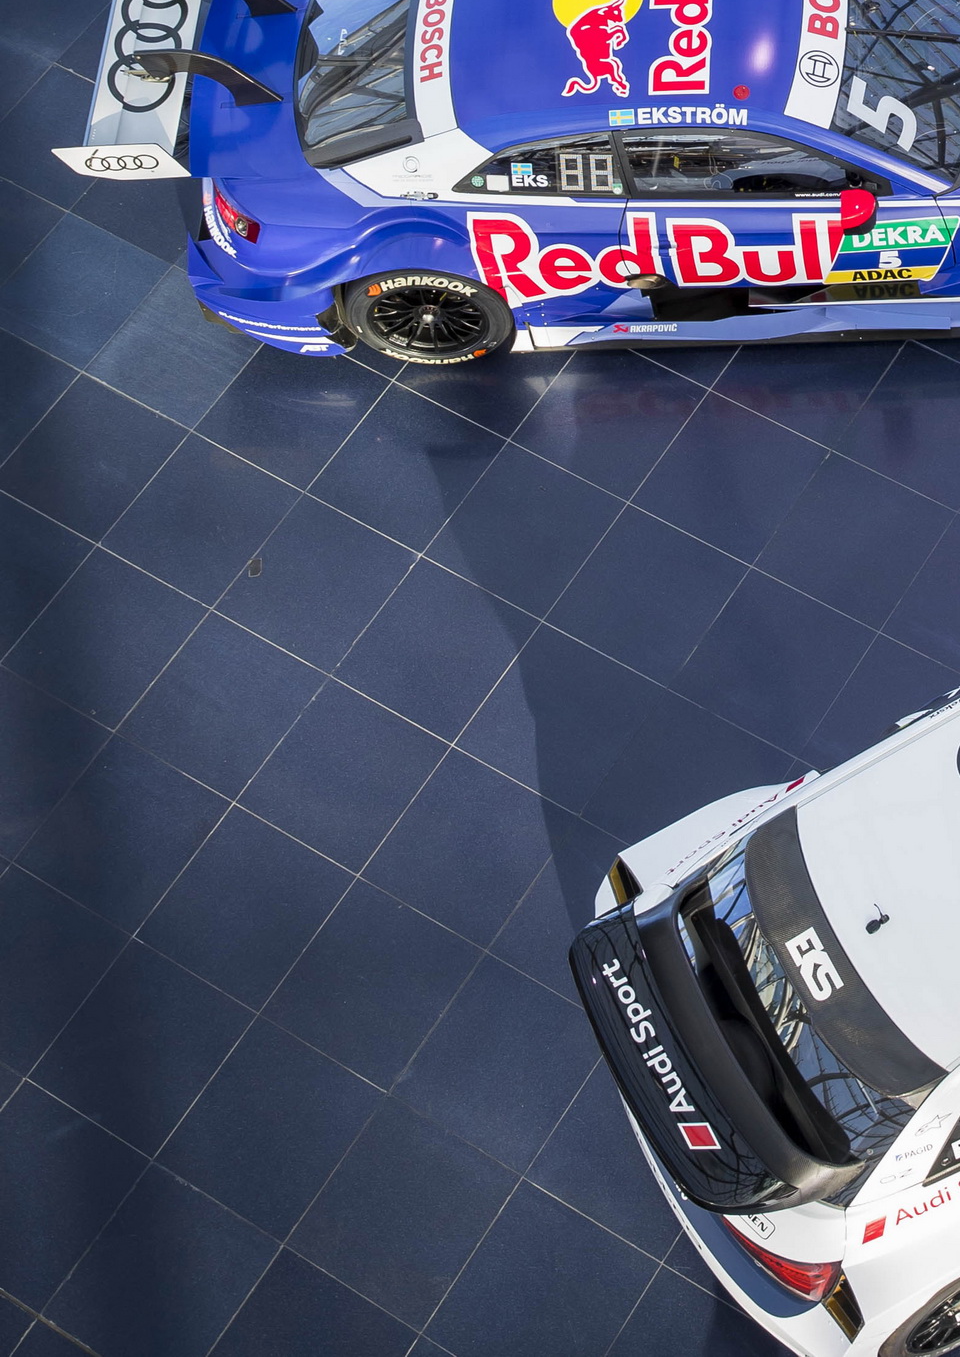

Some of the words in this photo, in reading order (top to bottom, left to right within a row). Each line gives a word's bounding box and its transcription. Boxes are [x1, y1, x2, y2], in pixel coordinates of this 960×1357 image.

[637, 104, 748, 127] EKSTRÖM
[847, 76, 918, 152] 5
[852, 224, 945, 248] DEKRA
[468, 212, 659, 303] Red
[667, 215, 843, 288] Bull
[852, 268, 913, 282] ADAC
[878, 250, 902, 269] 5
[785, 927, 844, 1002] EKS
[602, 958, 655, 1045] Sport
[642, 1049, 696, 1112] Audi
[904, 1143, 933, 1158] PAGID
[895, 1186, 951, 1226] Audi
